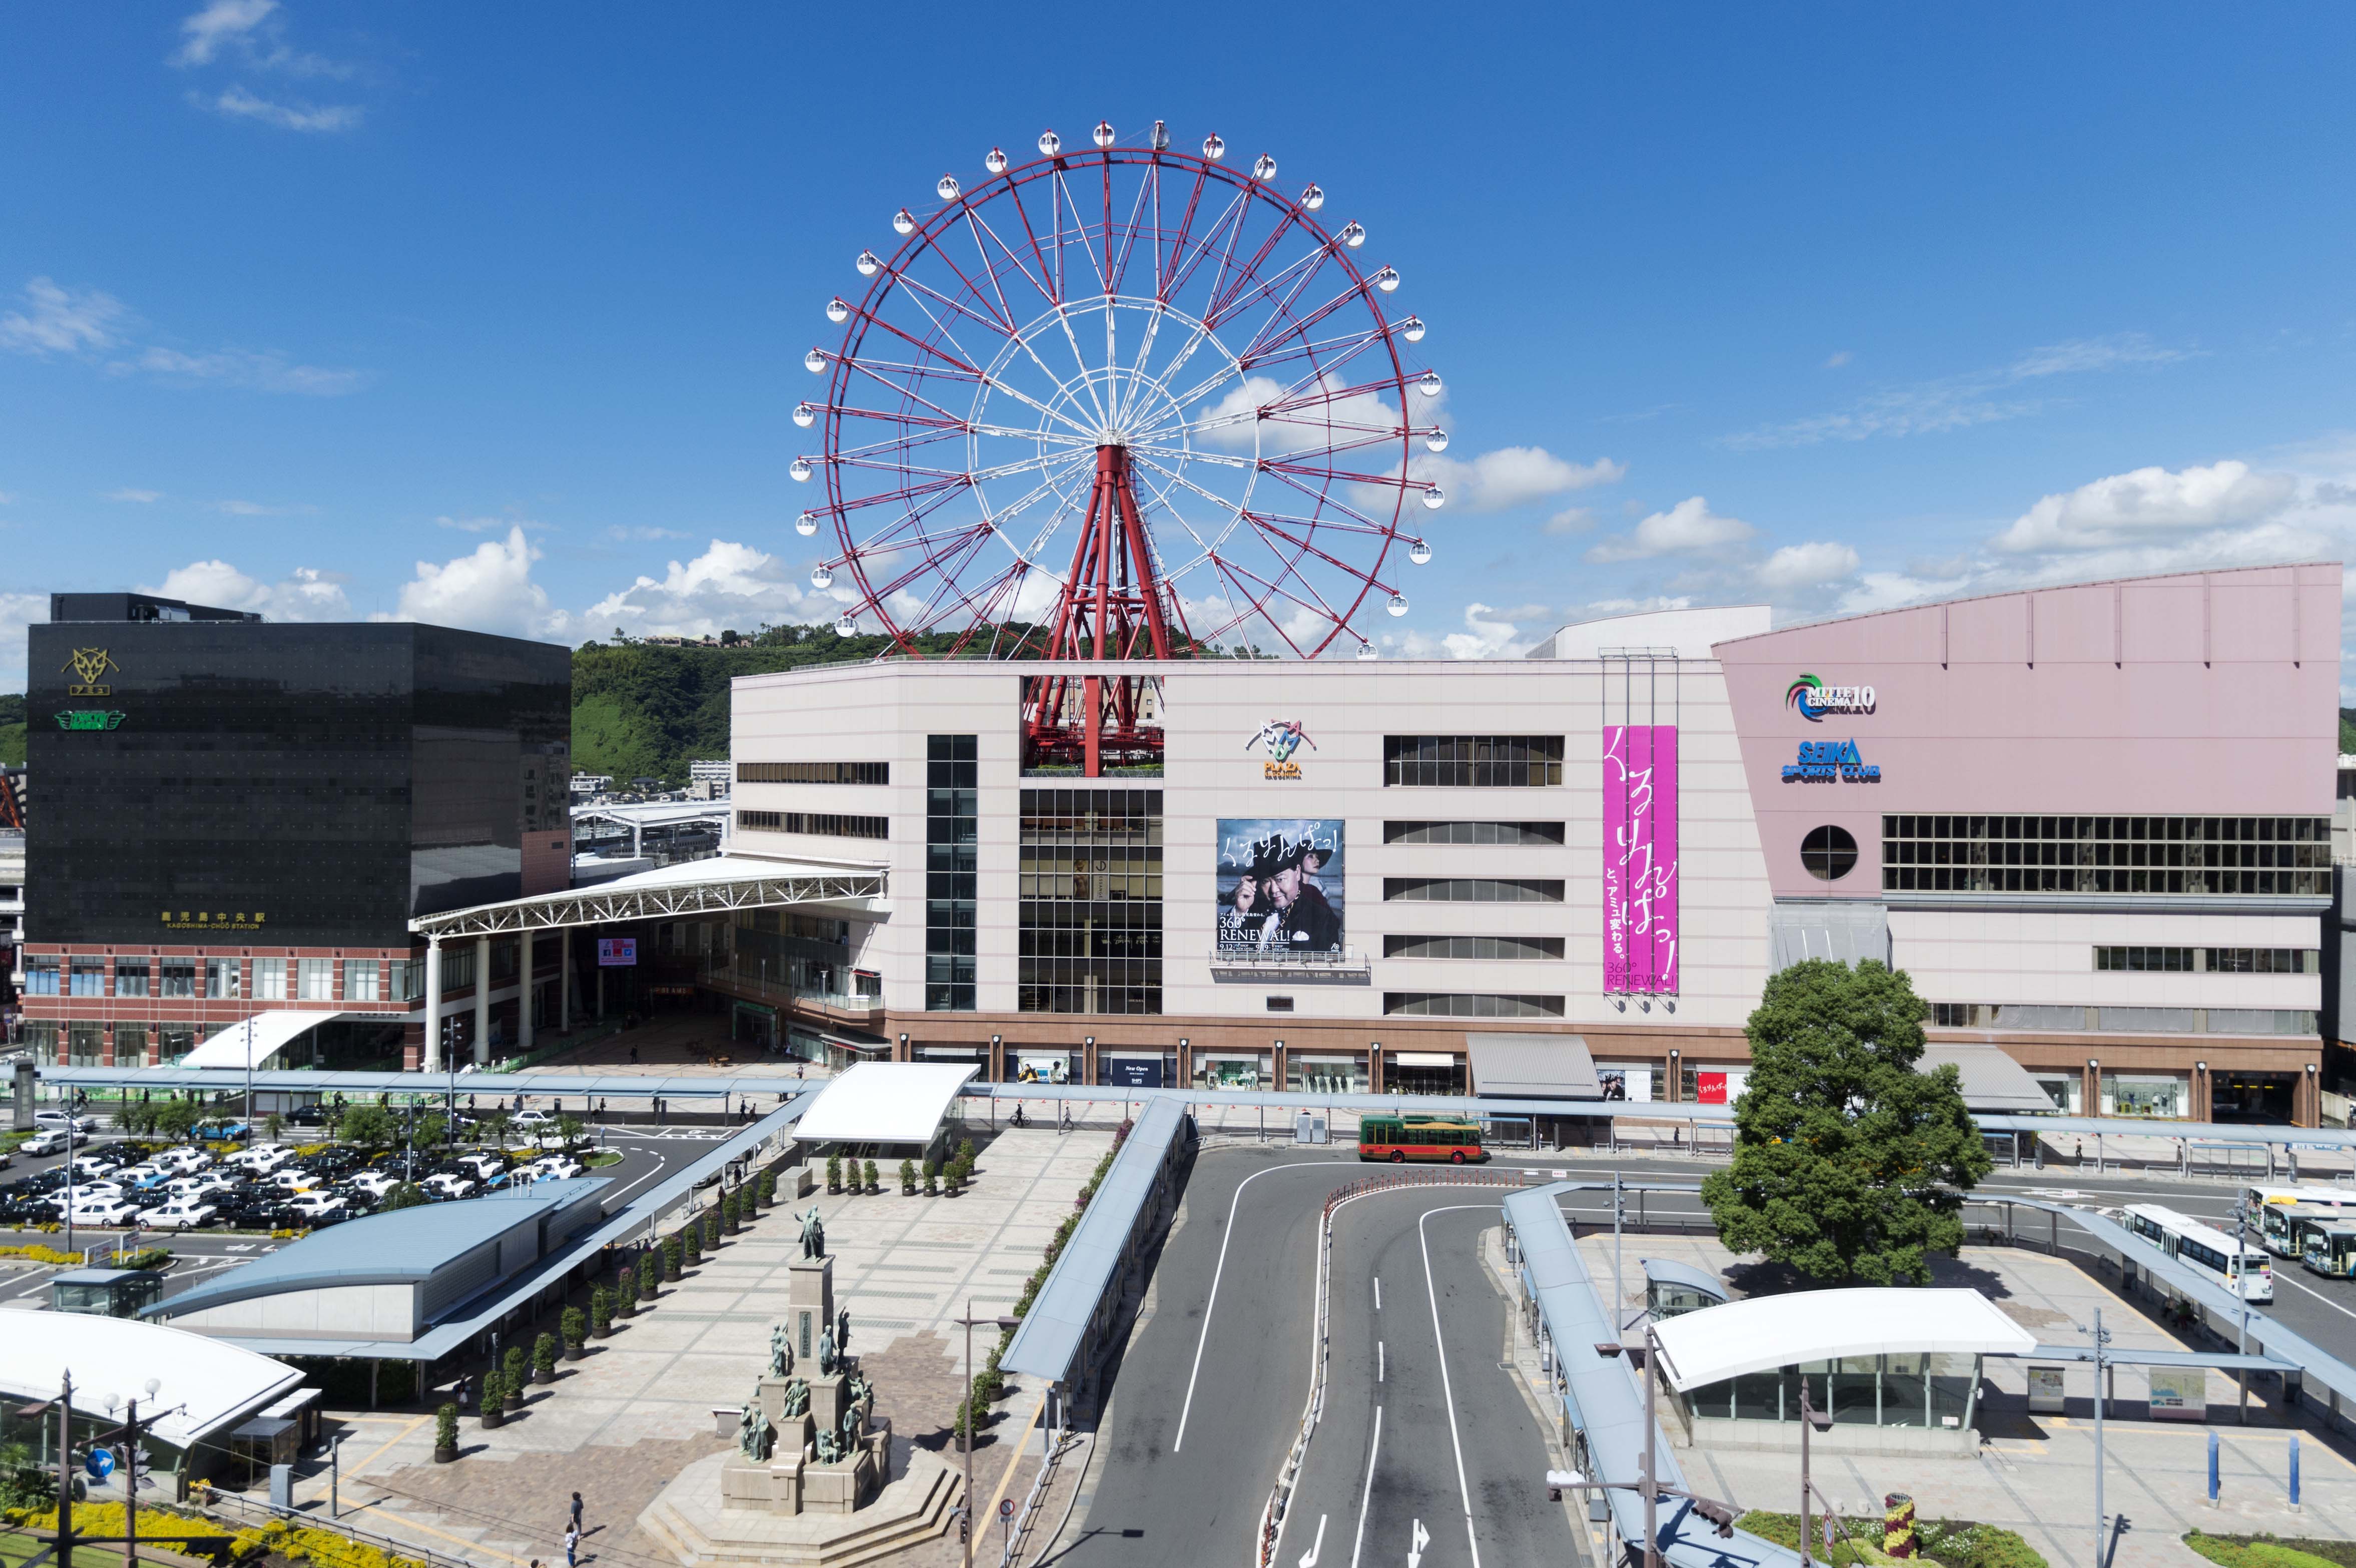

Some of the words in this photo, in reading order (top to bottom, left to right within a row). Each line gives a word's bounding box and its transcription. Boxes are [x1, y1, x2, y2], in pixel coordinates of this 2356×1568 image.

[1807, 687, 1851, 697] MITTE
[1851, 686, 1875, 707] 10
[1807, 698, 1851, 707] CINEMA
[1797, 737, 1862, 763] SEIKA
[1264, 761, 1301, 770] PLAZA
[1781, 765, 1835, 776] SPORTS
[1841, 765, 1880, 776] CLUB
[162, 912, 265, 922] 鹿児島中央駅
[1607, 868, 1625, 959] と、アミュ変わる。
[1220, 917, 1245, 928] 360°
[1220, 929, 1290, 941] RENEWAL!
[1607, 962, 1637, 973] 360°
[1607, 975, 1674, 985] RENEWAL!
